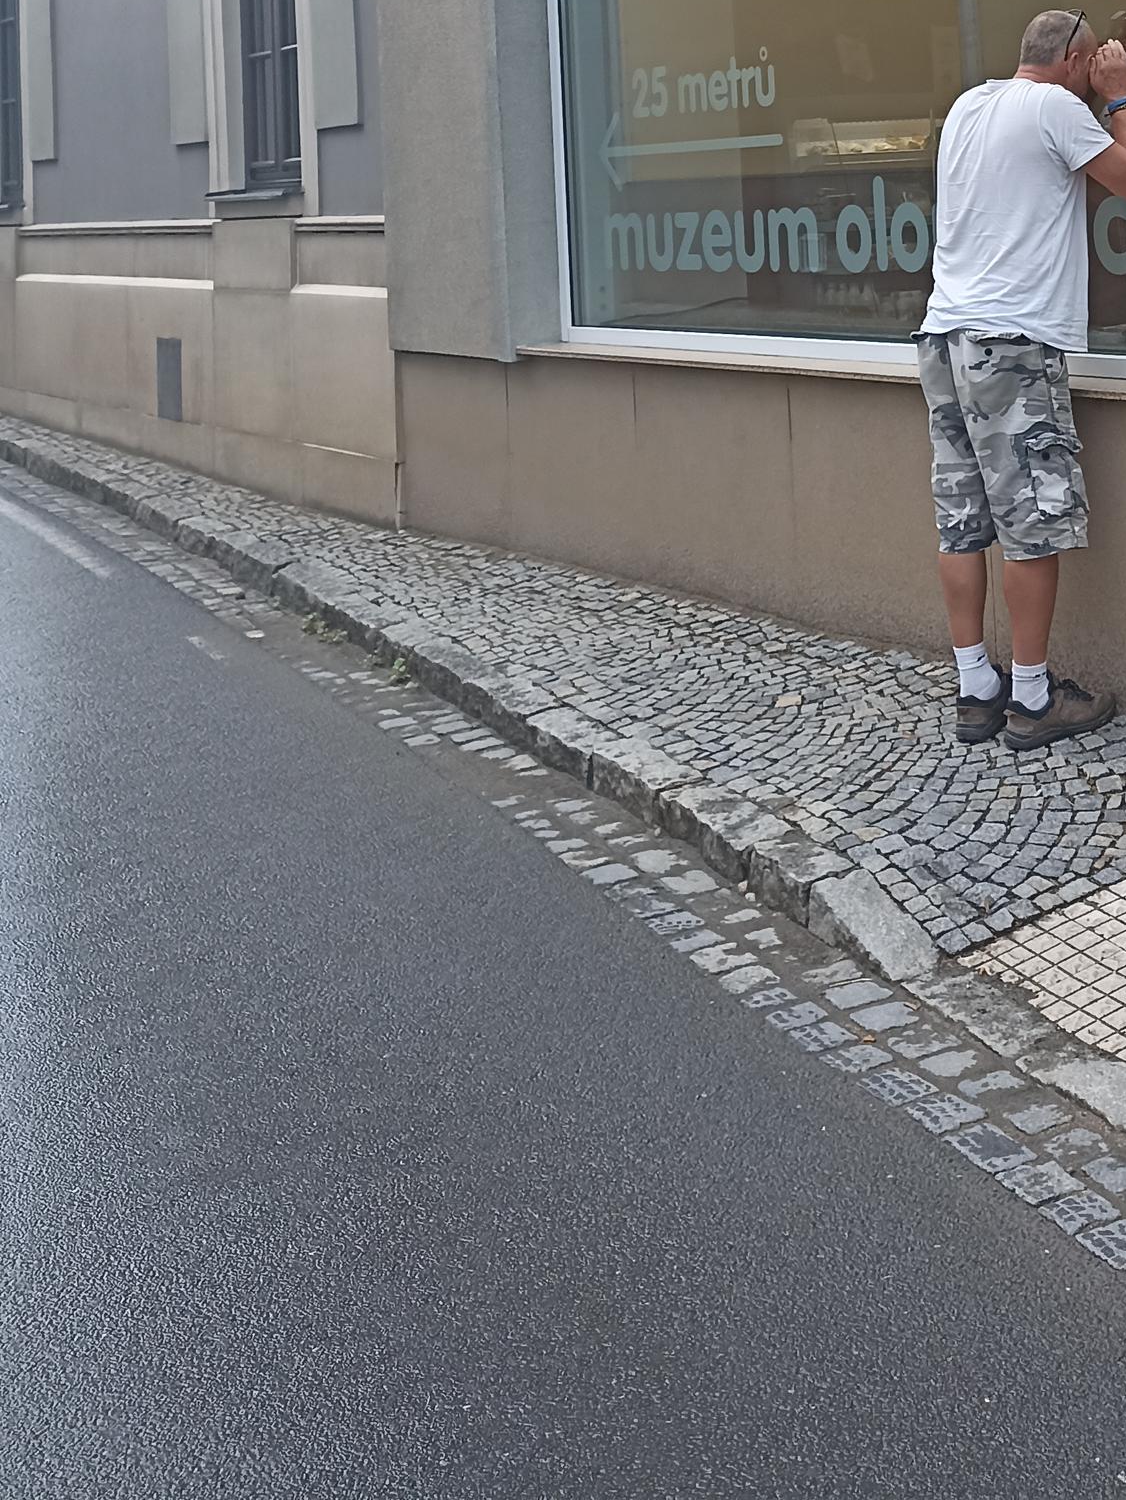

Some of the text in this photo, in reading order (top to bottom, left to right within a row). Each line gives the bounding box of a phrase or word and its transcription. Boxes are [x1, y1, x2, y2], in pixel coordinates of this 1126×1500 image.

[631, 46, 776, 118] 25 metrů
[604, 207, 819, 273] muzeum
